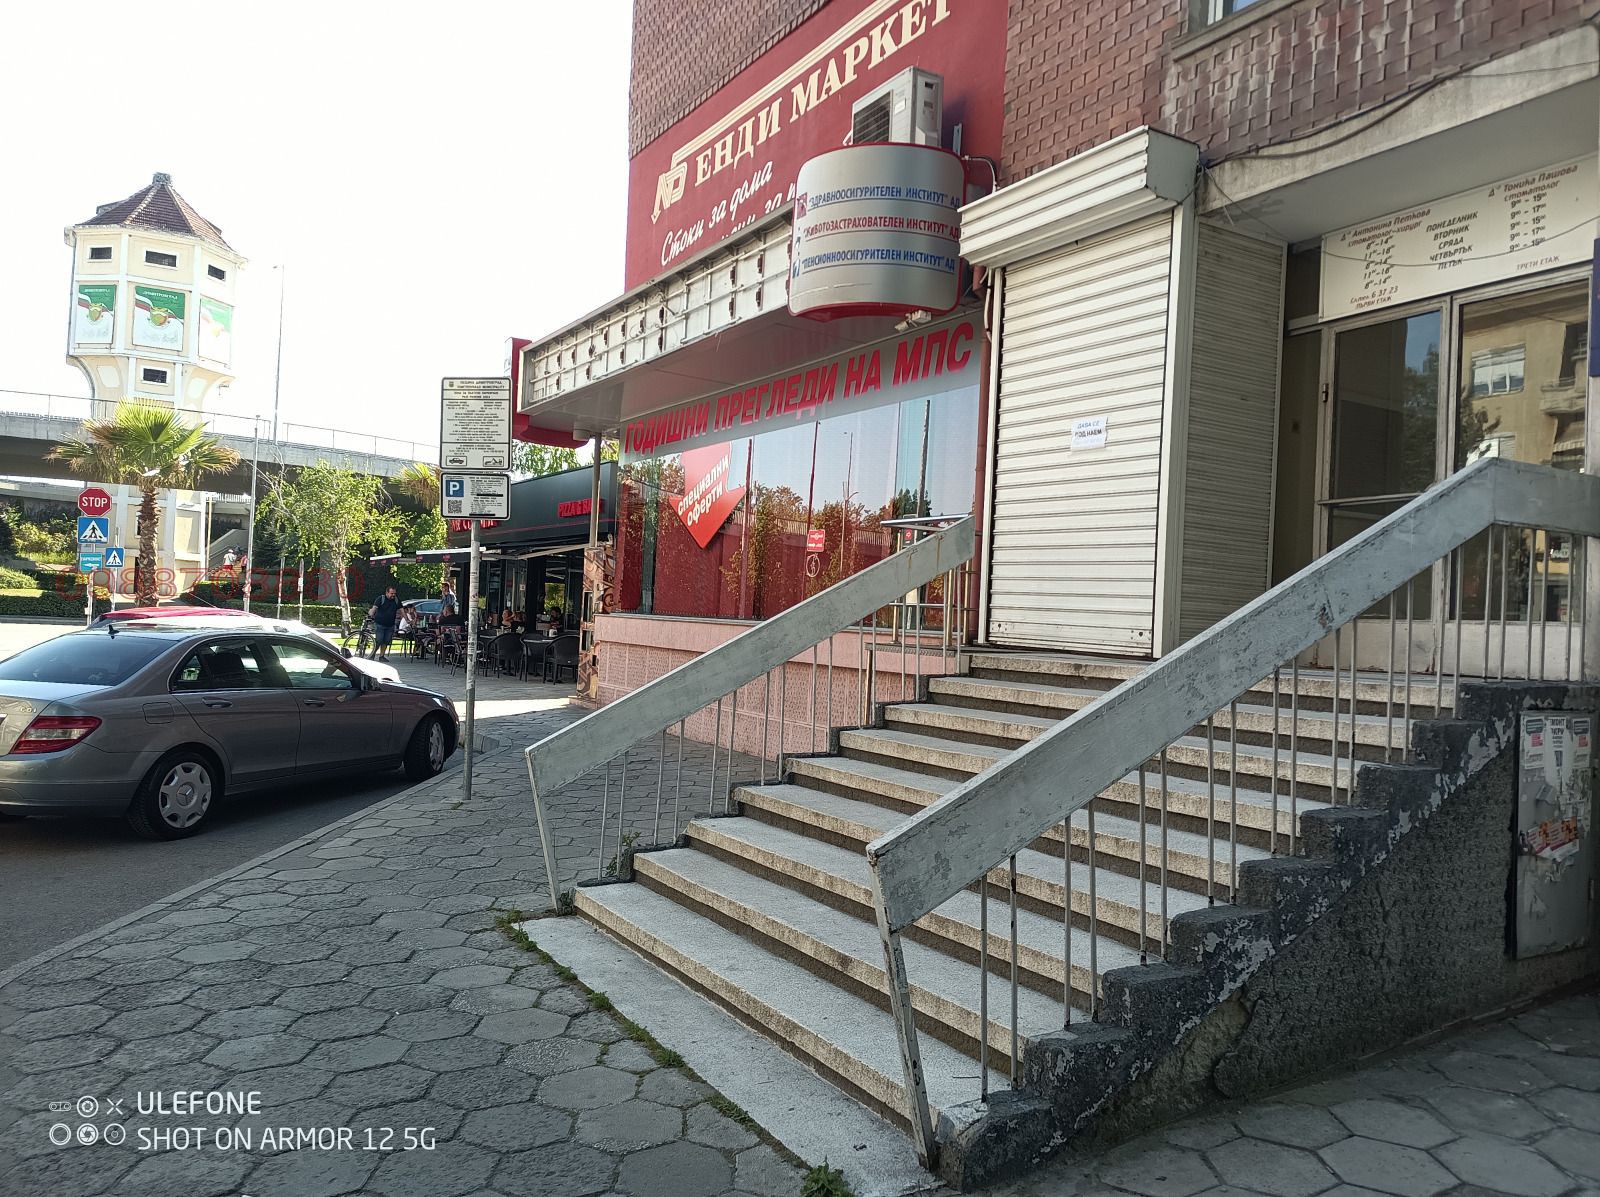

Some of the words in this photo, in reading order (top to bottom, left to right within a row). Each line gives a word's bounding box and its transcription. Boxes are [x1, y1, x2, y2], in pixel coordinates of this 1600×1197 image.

[694, 97, 782, 187] ЕНДИ
[790, 0, 951, 123] МАРКЕТ
[1504, 180, 1561, 202] стоматолог
[950, 196, 961, 209] АД
[661, 218, 705, 267] Стоки
[708, 199, 728, 229] за
[730, 160, 773, 222] дома
[1426, 210, 1478, 233] ПОНЕДЕЛНИК
[949, 226, 959, 240] АД
[1433, 223, 1470, 241] ВТОРНИК
[1438, 236, 1464, 250] СРЯДА
[1429, 244, 1474, 262] ЧЕТВЪРТЪК
[945, 257, 955, 272] АД
[1437, 257, 1463, 271] ПЕТЪК
[1516, 260, 1539, 271] ТРЕТИ
[1540, 255, 1560, 265] ЕТАЖ
[1371, 290, 1377, 298] 6
[624, 400, 711, 456] ГОДИШНИ
[714, 362, 838, 431] ПРЕГЛЕДИ
[843, 349, 882, 399] НА
[893, 321, 974, 388] МПС
[1087, 429, 1102, 437] НАЕМ
[449, 481, 460, 496] P
[677, 455, 729, 517] специални
[82, 496, 108, 508] STOP
[687, 480, 724, 527] оферти
